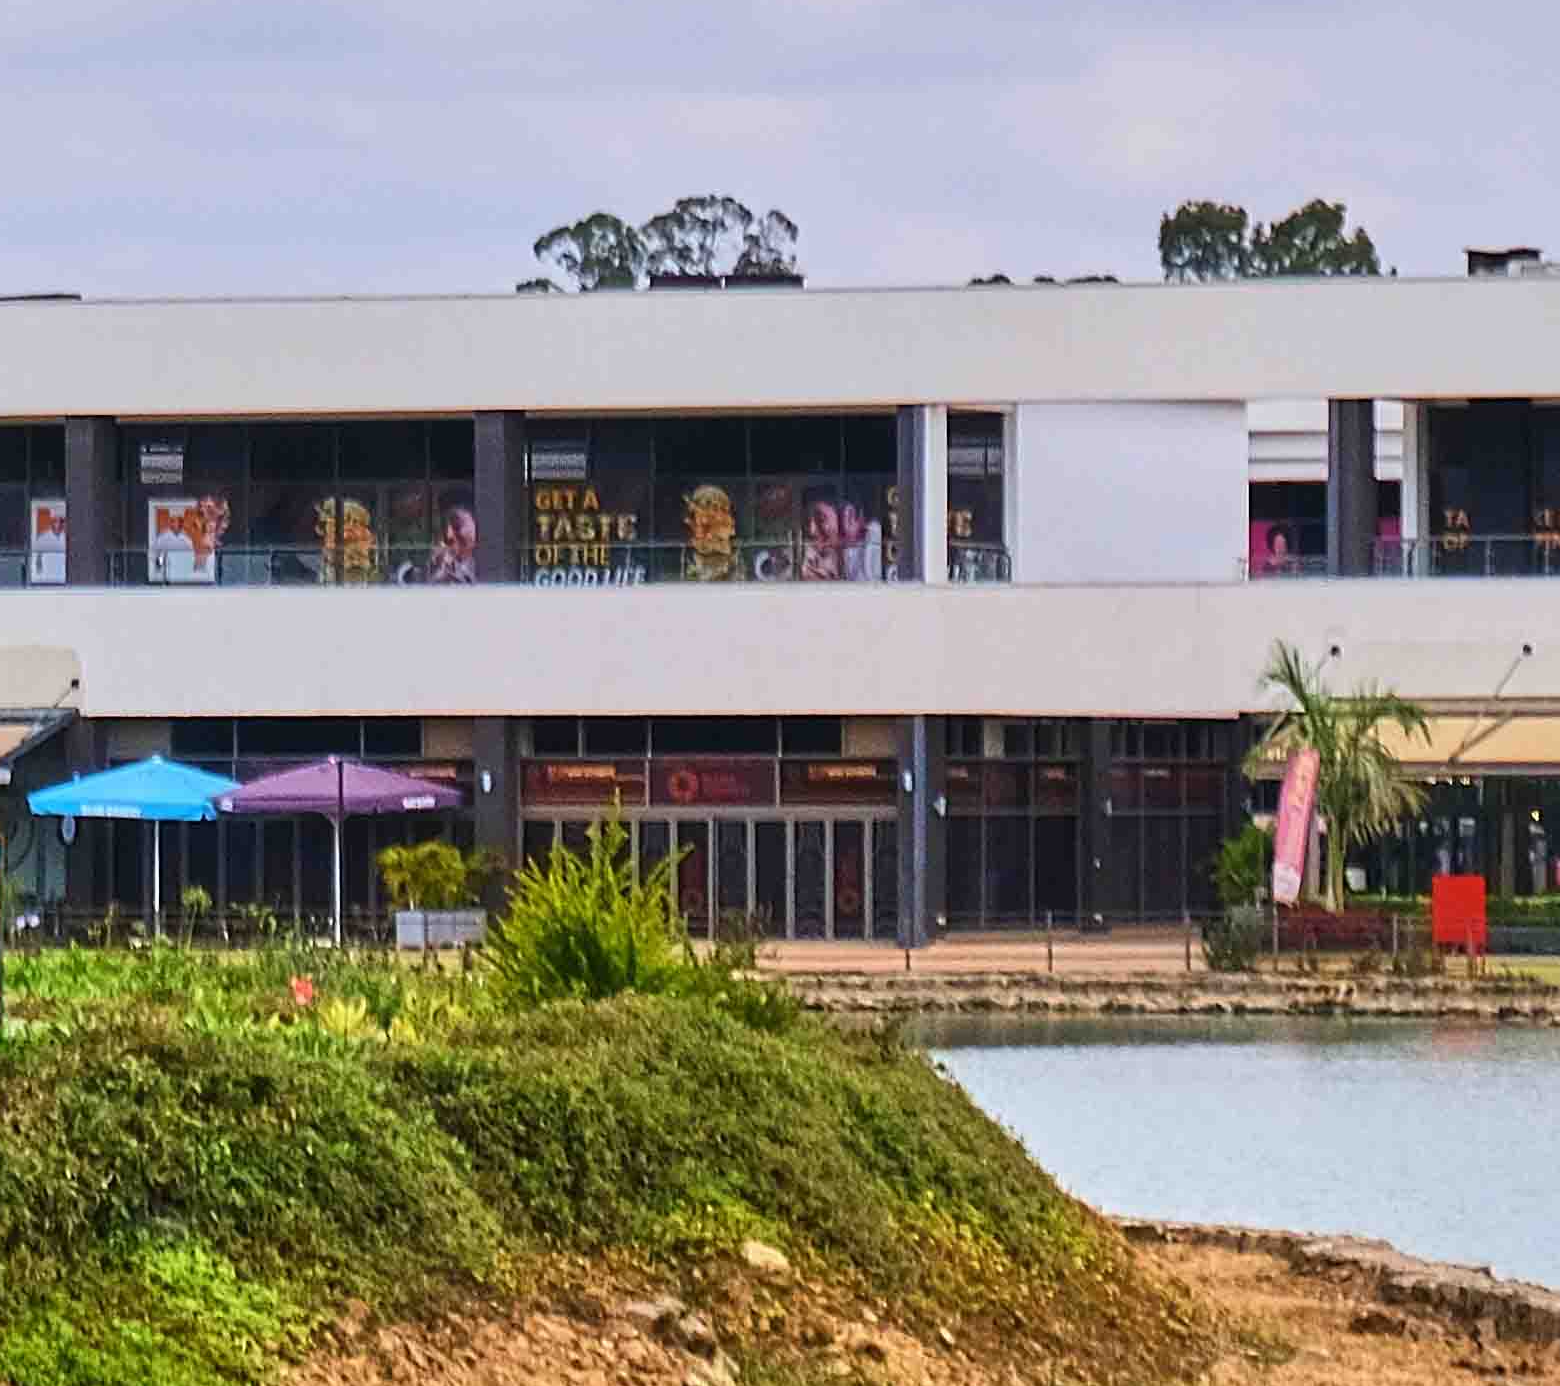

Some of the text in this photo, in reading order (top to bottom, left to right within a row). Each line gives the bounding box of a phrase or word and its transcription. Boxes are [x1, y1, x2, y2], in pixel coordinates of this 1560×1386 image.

[536, 489, 599, 509] GET A
[536, 514, 638, 541] TASTE
[536, 545, 610, 566] OF THE
[536, 567, 600, 588] GOOD
